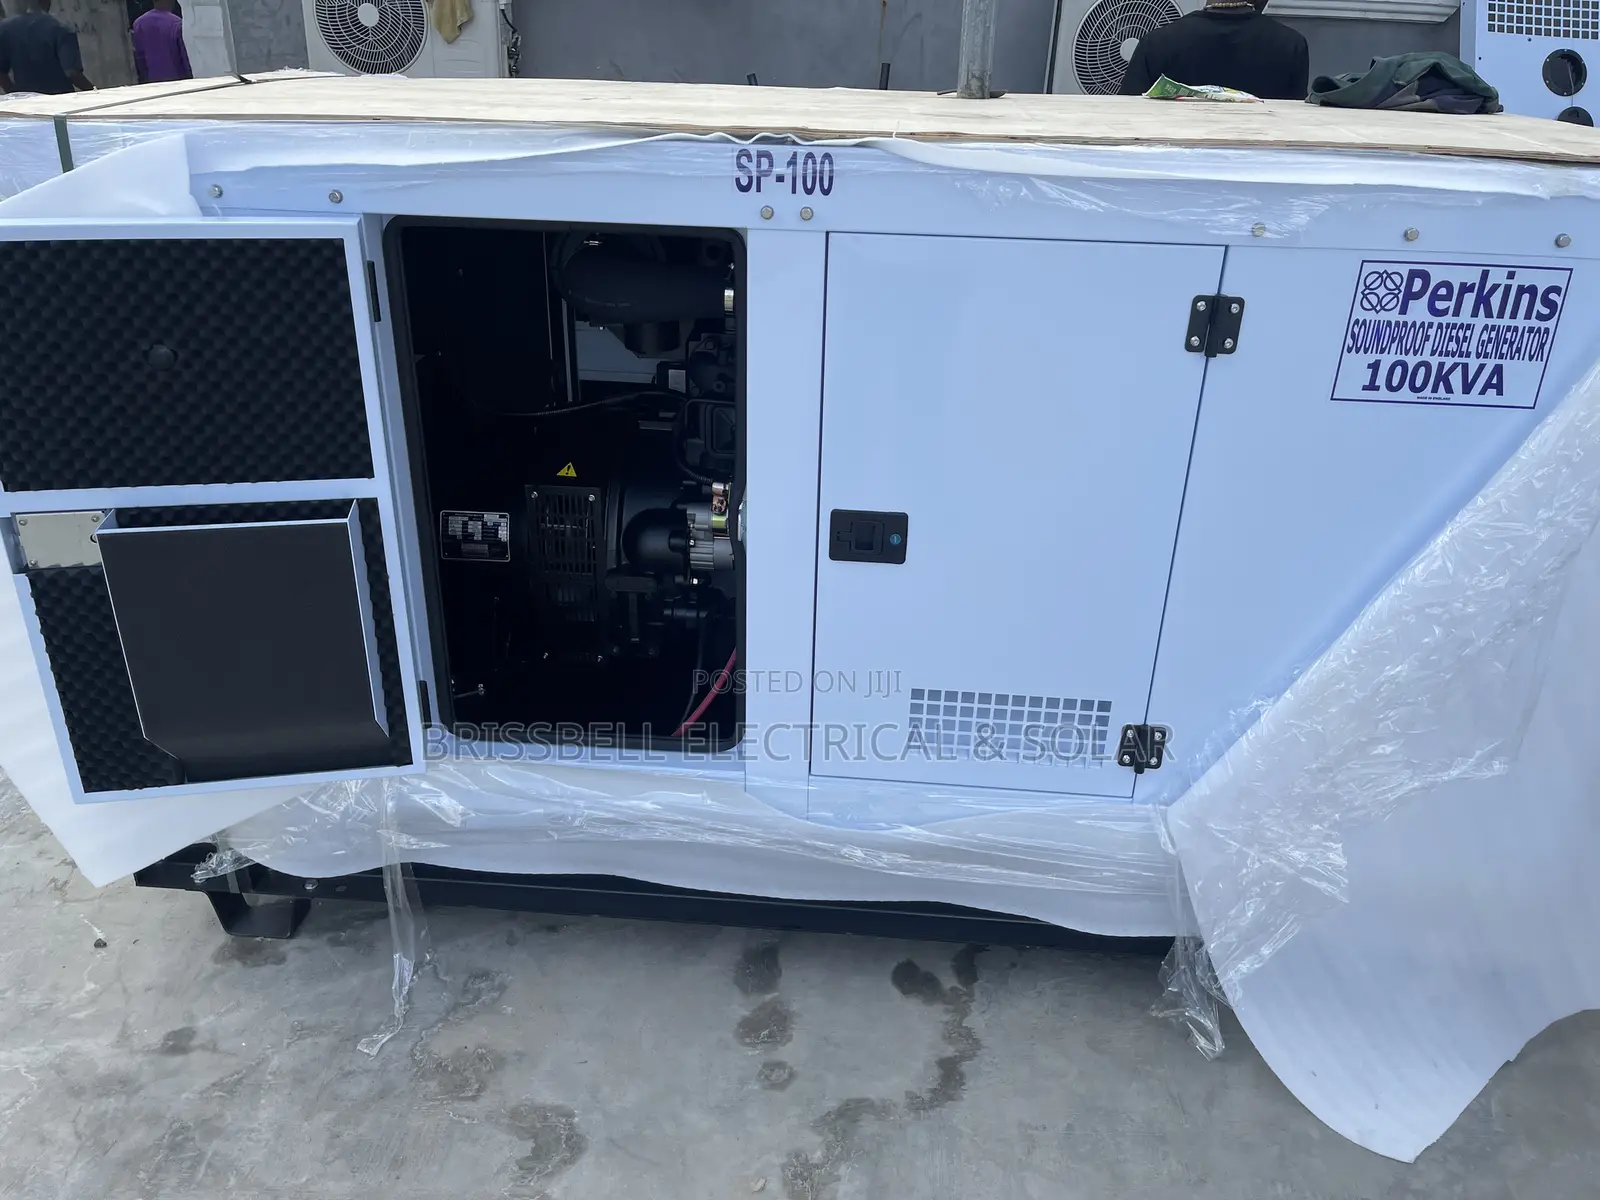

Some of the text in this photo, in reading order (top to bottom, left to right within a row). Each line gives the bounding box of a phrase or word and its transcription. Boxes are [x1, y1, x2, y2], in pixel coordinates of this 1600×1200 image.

[735, 148, 834, 196] SP-100
[1398, 268, 1563, 322] Perkins
[1346, 318, 1550, 362] SOUNDPROOF DIESEL GENERATOR
[1361, 359, 1504, 396] 100KVA
